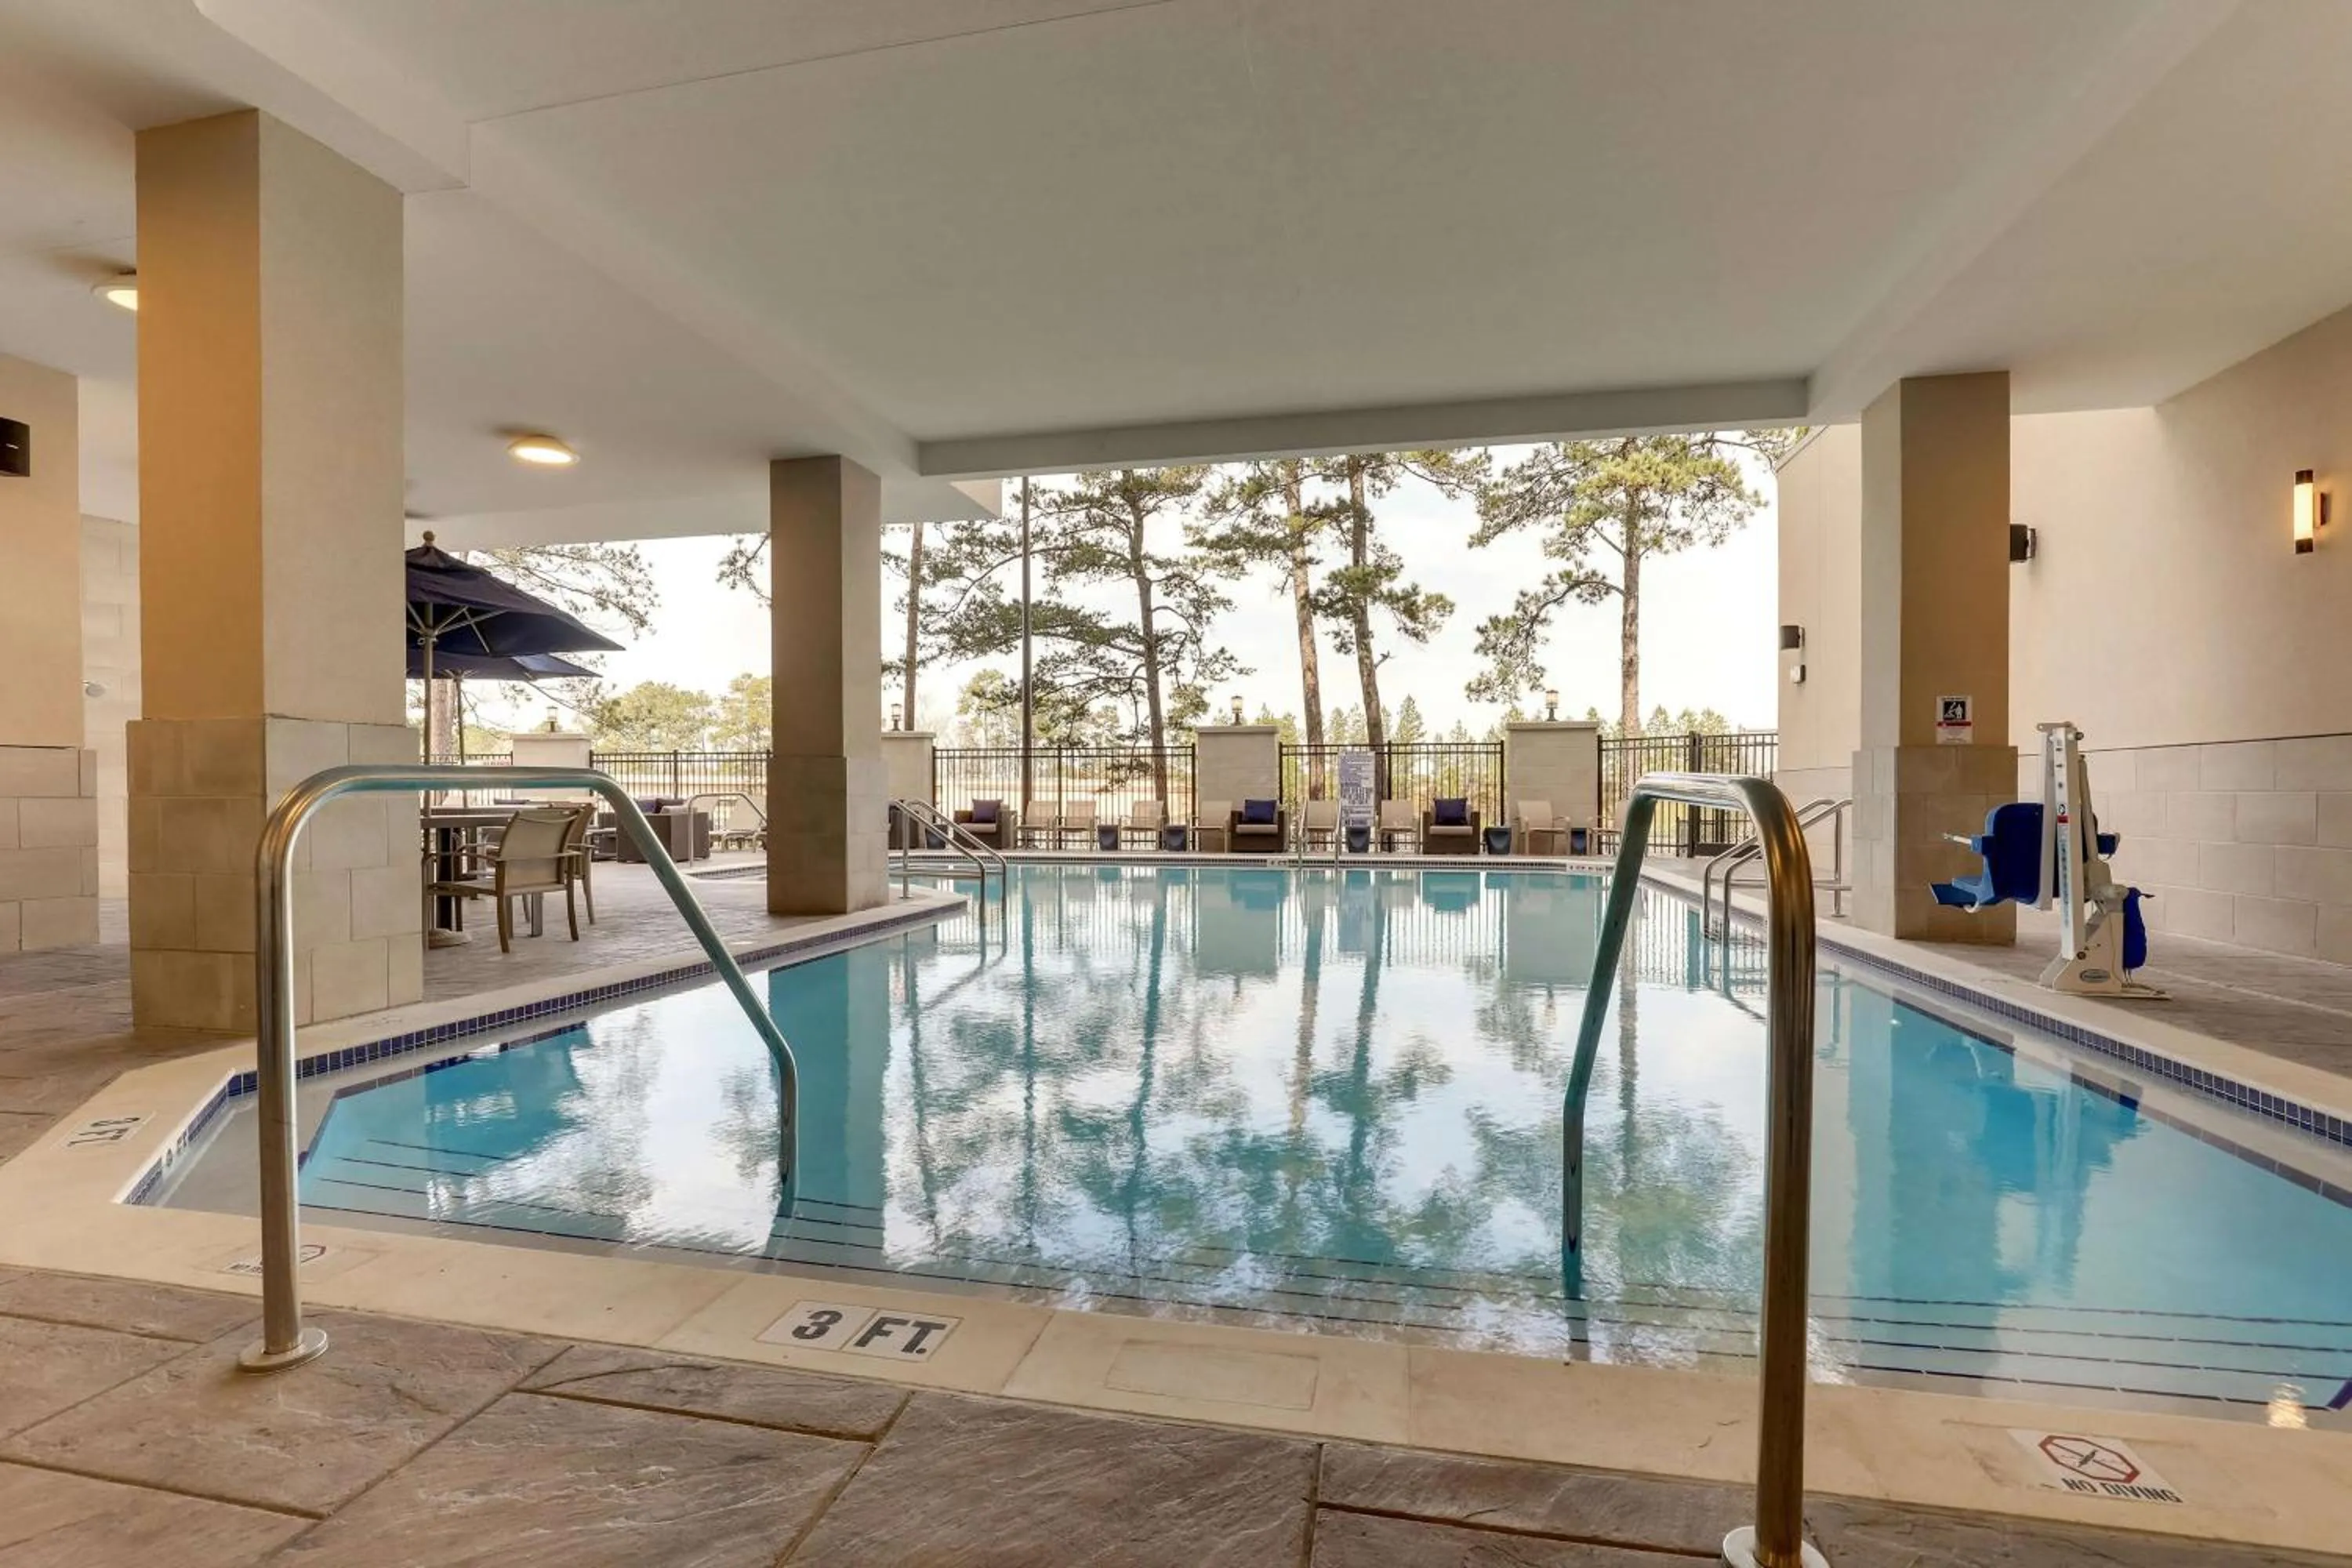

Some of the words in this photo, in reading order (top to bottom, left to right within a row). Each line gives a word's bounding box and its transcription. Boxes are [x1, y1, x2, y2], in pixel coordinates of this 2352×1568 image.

[792, 1310, 843, 1340] 3
[854, 1316, 946, 1354] FT.
[2061, 1478, 2098, 1493] NO
[2100, 1483, 2183, 1503] DIVING
